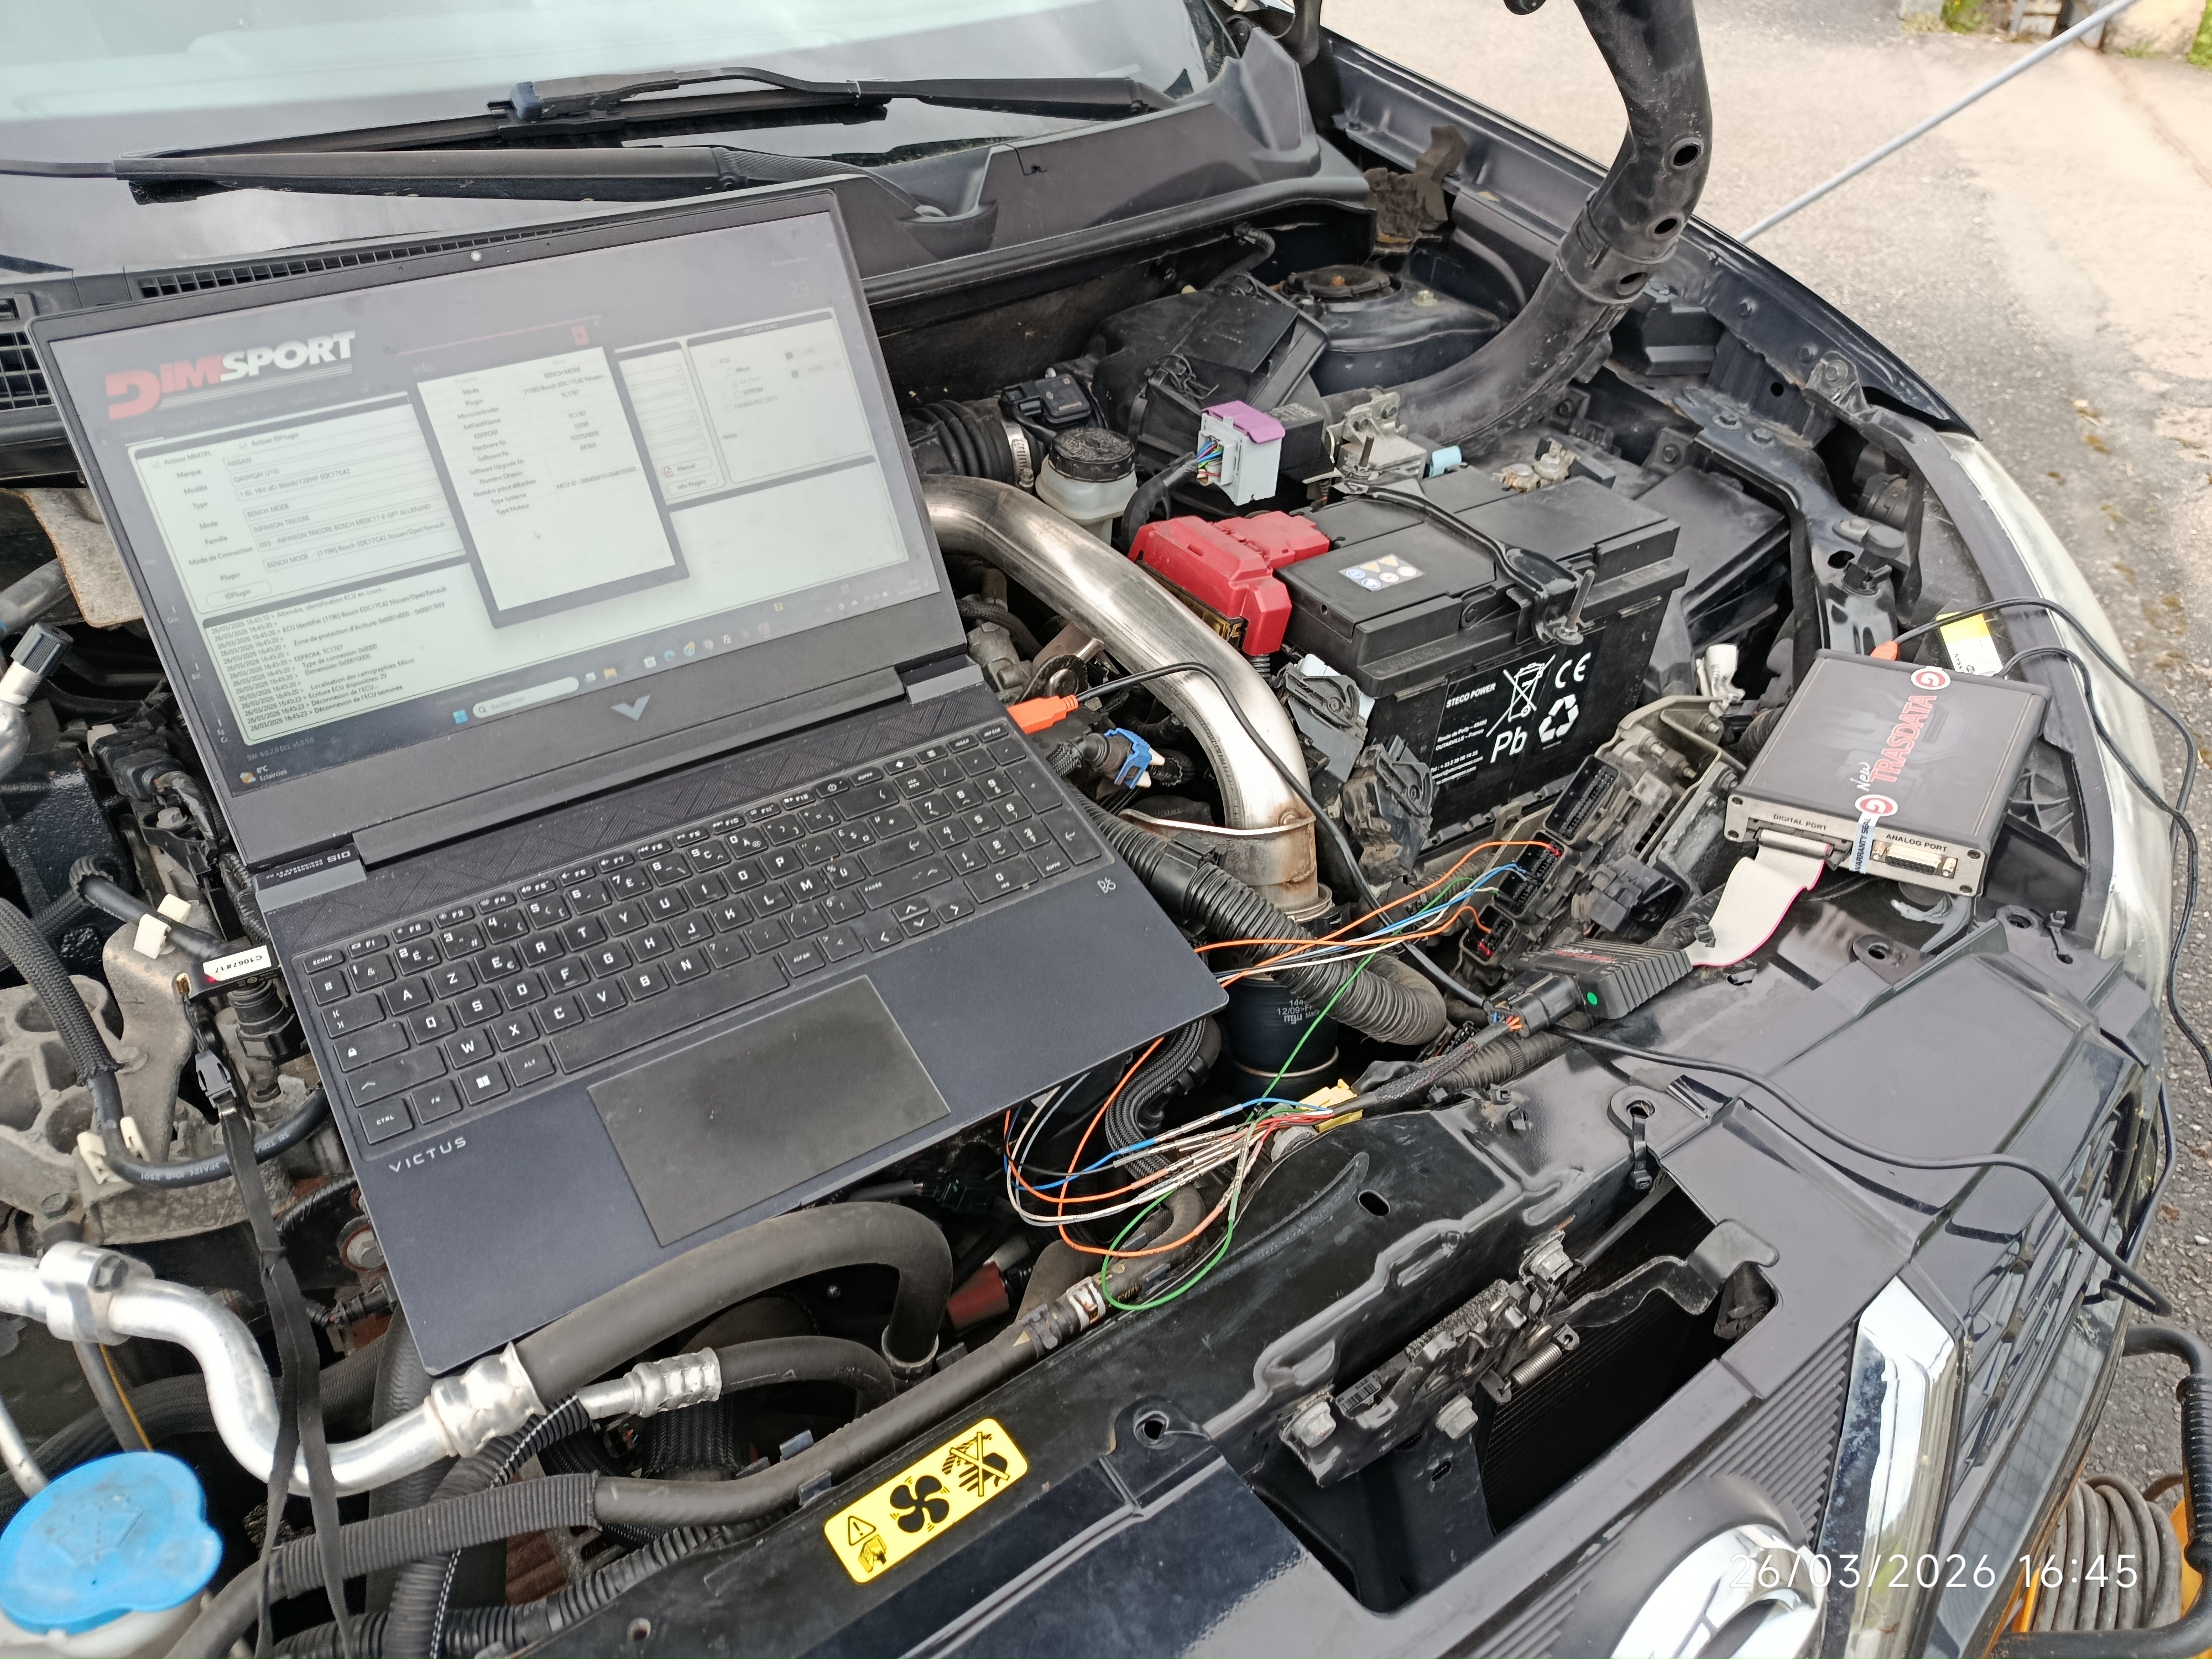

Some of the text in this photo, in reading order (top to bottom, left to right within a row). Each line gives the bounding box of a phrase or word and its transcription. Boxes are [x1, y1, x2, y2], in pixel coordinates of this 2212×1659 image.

[411, 361, 435, 375] Info
[457, 406, 500, 420] Microcontroller
[473, 429, 498, 440] EEPROM
[471, 441, 499, 451] Hardware
[227, 457, 252, 467] NISSAN
[477, 451, 501, 462] Software
[176, 468, 202, 479] Marque
[233, 471, 264, 483] QASHQAI
[239, 489, 254, 498] 1.6L
[254, 486, 267, 494] 16V
[320, 468, 351, 481] EDC17C42
[192, 500, 209, 510] Type
[247, 503, 290, 517] BENCH MODE
[495, 507, 510, 516] Type
[199, 520, 219, 530] Mode
[252, 515, 311, 533] INFINEON TRICORE
[276, 531, 307, 544] INFINEON
[307, 525, 333, 537] TRICORE
[333, 520, 356, 531] BOSCH
[355, 515, 381, 526] MEDC17
[204, 535, 228, 545] Famille
[188, 556, 208, 566] Mode
[217, 546, 254, 559] Connection
[266, 557, 289, 569] BENCH
[288, 552, 310, 564] MODE
[337, 542, 357, 552] Bosch
[356, 535, 388, 548] EDC17C42
[219, 571, 242, 582] Plugin
[223, 587, 252, 601] IDPlugin
[216, 635, 251, 649] 26/03/2026
[251, 629, 276, 640] 16:45:20
[228, 666, 263, 680] 26/03/2026
[263, 659, 288, 671] 16:45:20
[322, 644, 344, 655] TC1767
[1446, 682, 1496, 708] STECO POWER
[243, 703, 278, 717] 26/03/2026
[277, 696, 302, 707] 16:45:23
[249, 717, 283, 732] 26/03/2026
[283, 711, 308, 722] 16:45:23
[377, 684, 403, 696] terminée
[1490, 726, 1528, 763] Pb
[1868, 695, 1937, 782] TRASDATA
[1850, 761, 1870, 792] New
[1773, 814, 1827, 831] DIGITAL PORT
[1861, 818, 1871, 834] SEAL
[1886, 833, 1948, 852] ANALOG PORT
[400, 988, 413, 1001] A
[446, 972, 459, 984] Z
[490, 956, 503, 969] E
[576, 925, 589, 938] T
[618, 911, 631, 924] Y
[658, 897, 671, 909] U
[774, 856, 787, 868] P
[470, 999, 484, 1013] S
[559, 967, 572, 980] F
[601, 951, 615, 965] G
[643, 936, 657, 950] H
[684, 921, 697, 935] J
[723, 907, 738, 920] K
[761, 893, 776, 906] L
[799, 879, 815, 892] M
[215, 955, 262, 973] C1067#17
[460, 958, 693, 1055] W X C V B N
[389, 1138, 467, 1173] VICTUS
